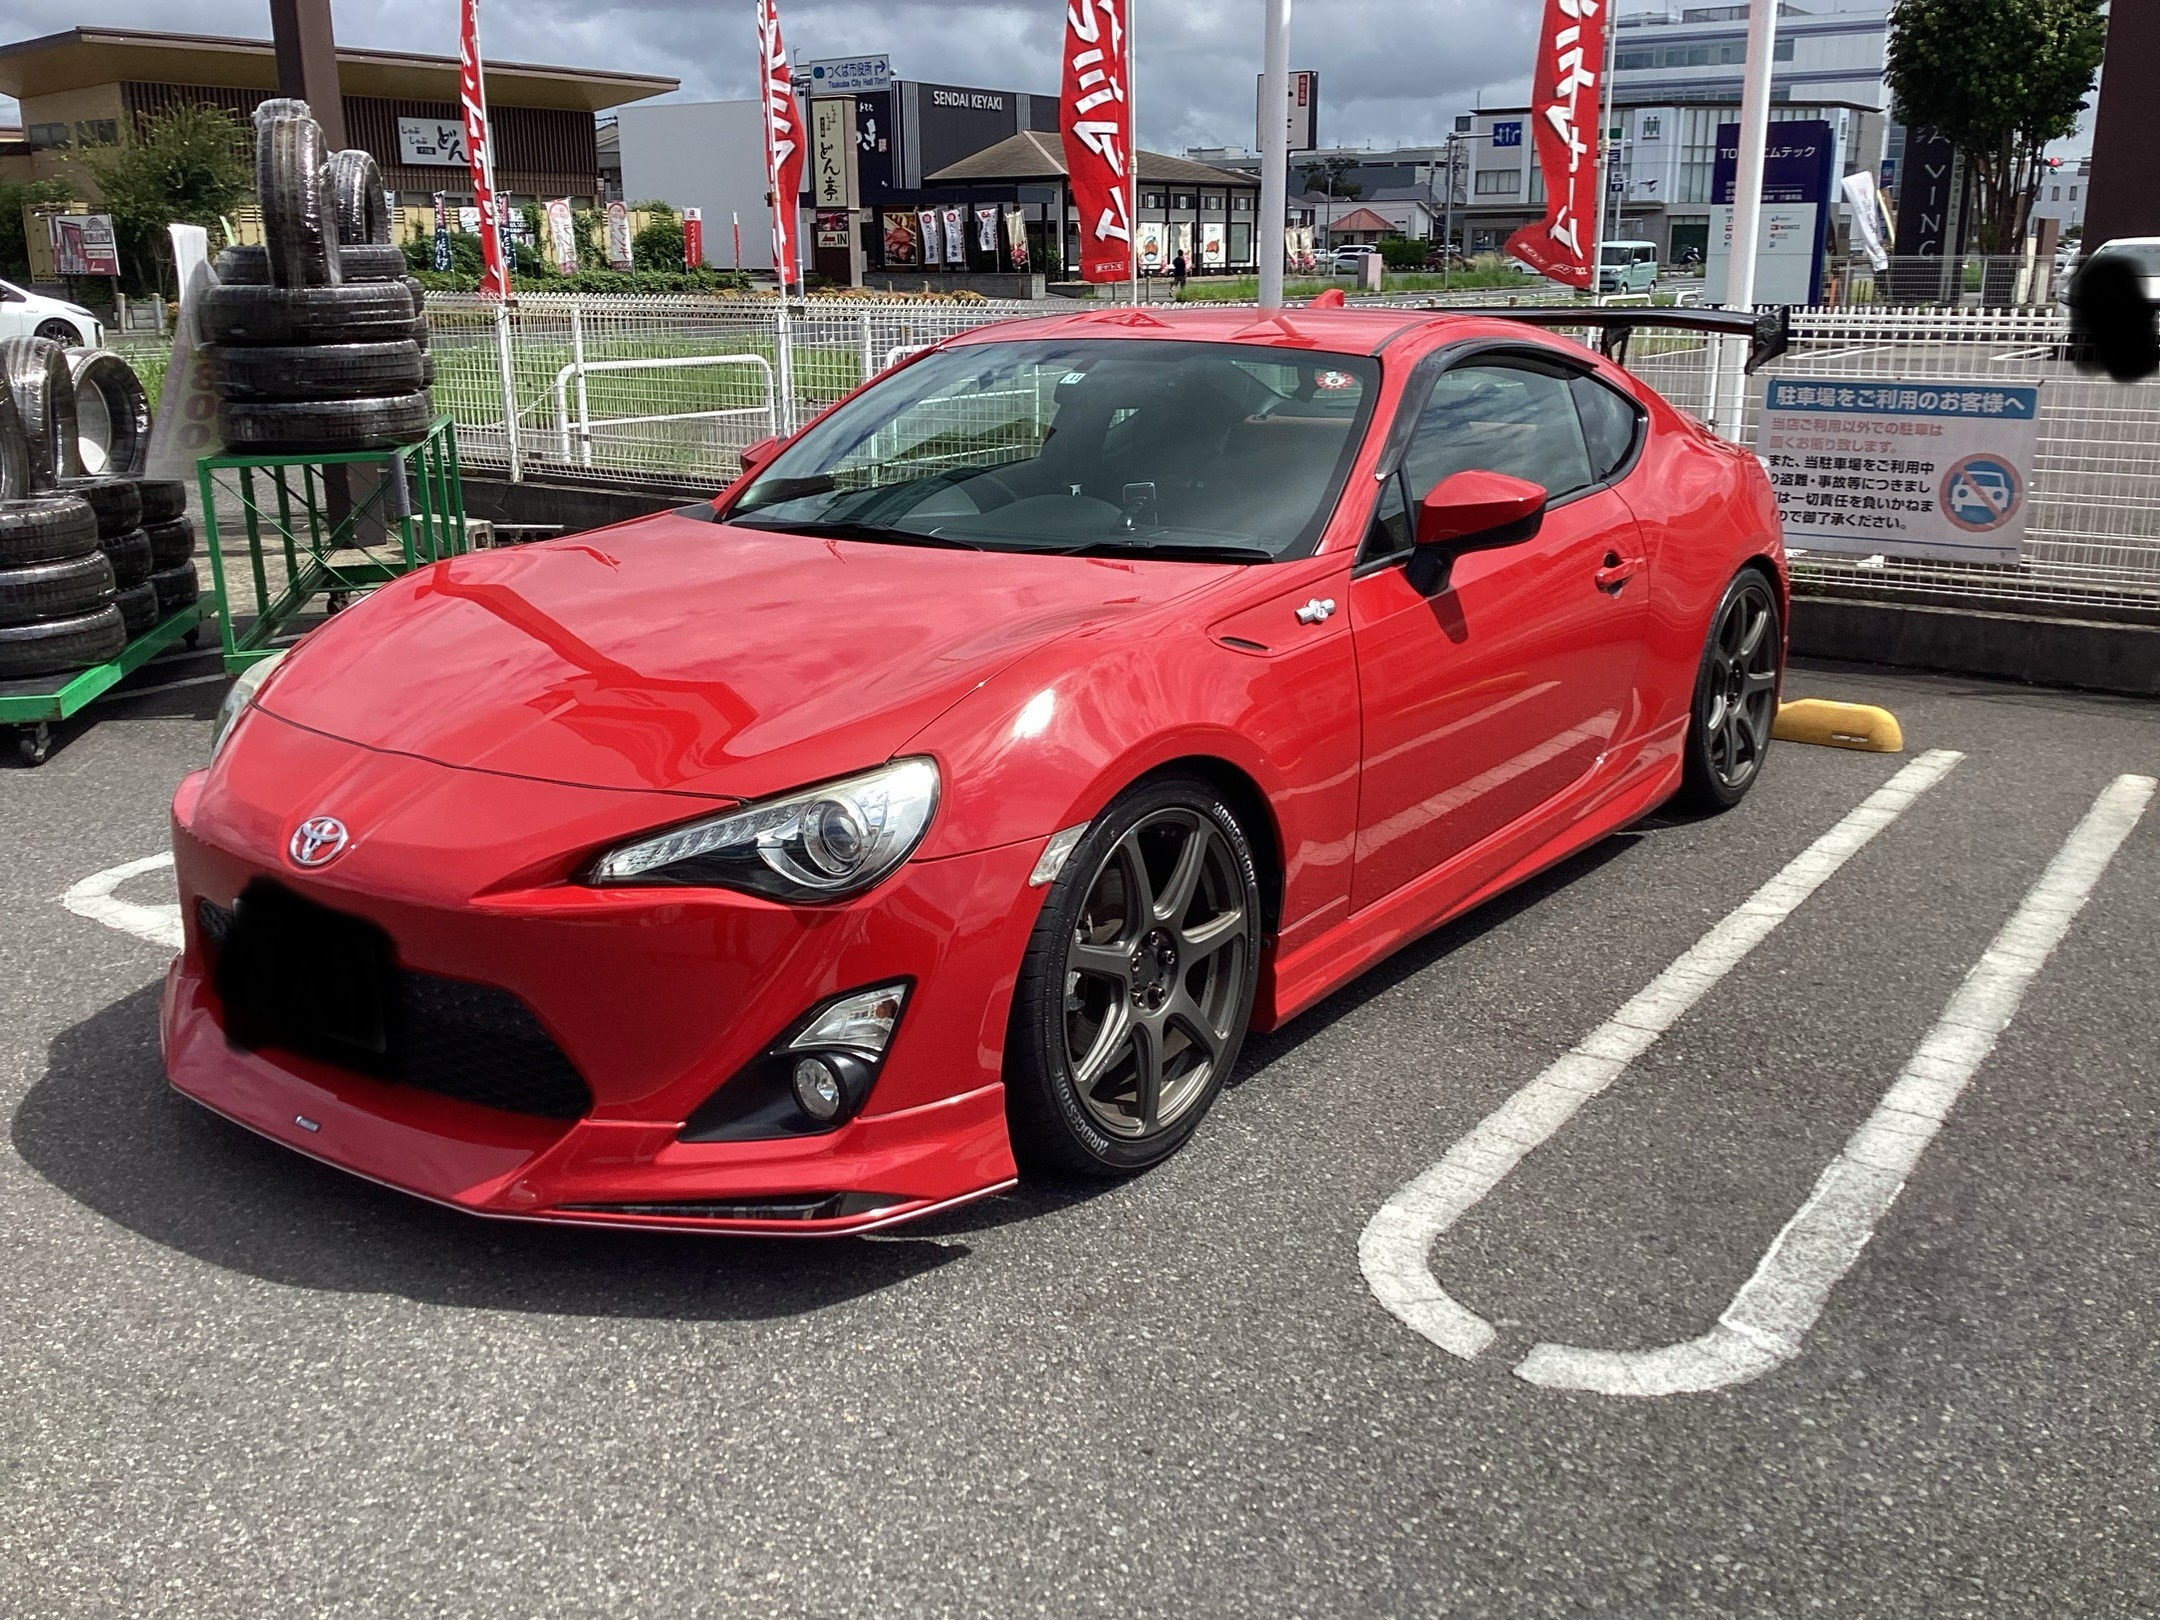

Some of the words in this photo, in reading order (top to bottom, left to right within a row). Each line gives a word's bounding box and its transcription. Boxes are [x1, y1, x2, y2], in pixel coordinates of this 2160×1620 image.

[826, 61, 872, 79] つくば市役所
[828, 80, 850, 89] Tsukuba
[851, 79, 862, 89] City
[863, 77, 873, 86] Hall
[933, 90, 969, 108] SENDAI
[971, 94, 1003, 111] KEYAKI
[820, 142, 840, 201] どん亭
[613, 223, 630, 260] ランチ
[837, 233, 848, 245] IN
[1776, 386, 2025, 413] 駐車場をご利用のお客様へ
[1771, 416, 1944, 437] 当店ご利用以外での駐車は
[1769, 435, 1898, 453] 固くお断り致します。
[1769, 455, 1935, 474] また、当駐車場をご利用中
[1054, 1067, 1110, 1156] BRIDGESTONE
